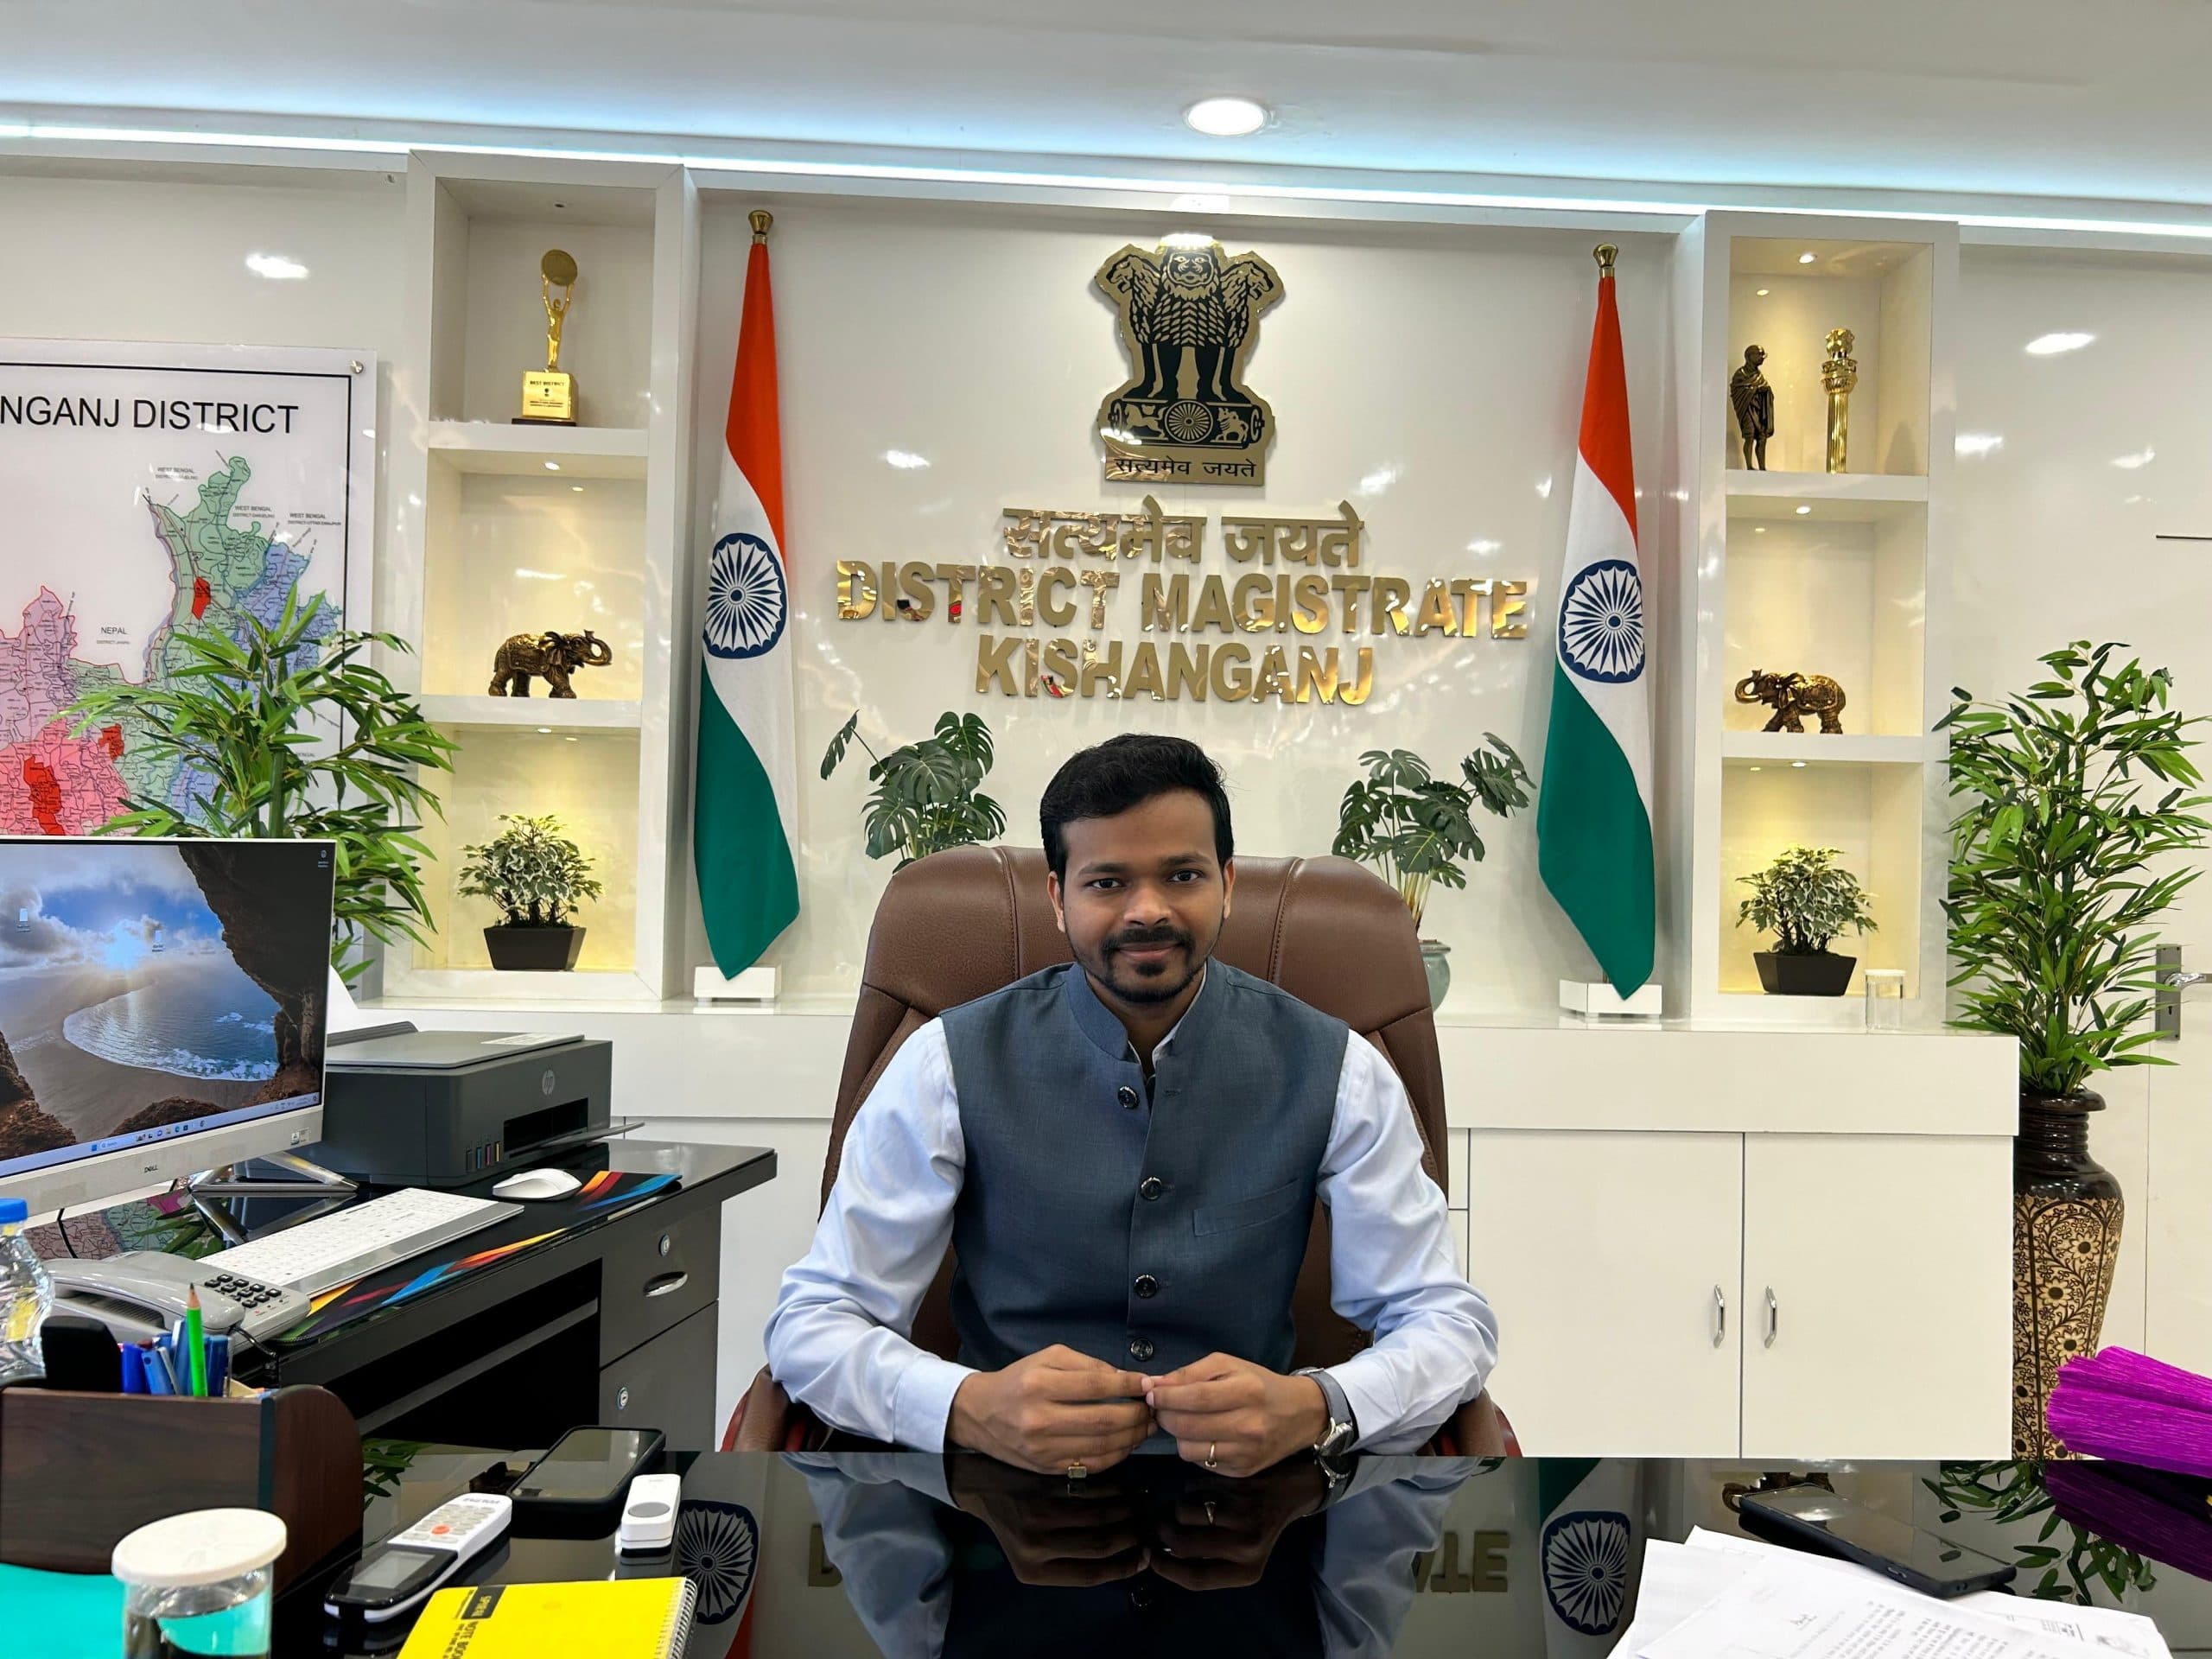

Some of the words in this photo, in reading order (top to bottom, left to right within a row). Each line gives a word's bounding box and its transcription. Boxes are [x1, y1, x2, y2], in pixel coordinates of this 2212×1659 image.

[133, 399, 299, 433] DISTRICT
[1114, 455, 1192, 475] सत्यमेव
[1202, 459, 1257, 477] जयते
[1003, 494, 1208, 563] सत्यमेव
[1221, 499, 1365, 567] जयते
[836, 560, 1121, 630] DISTRICT
[1141, 572, 1528, 639] MAGISTRATE
[100, 626, 128, 635] NEPAL
[976, 634, 1374, 707] KISHANGANJ
[143, 1165, 158, 1173] DELL
